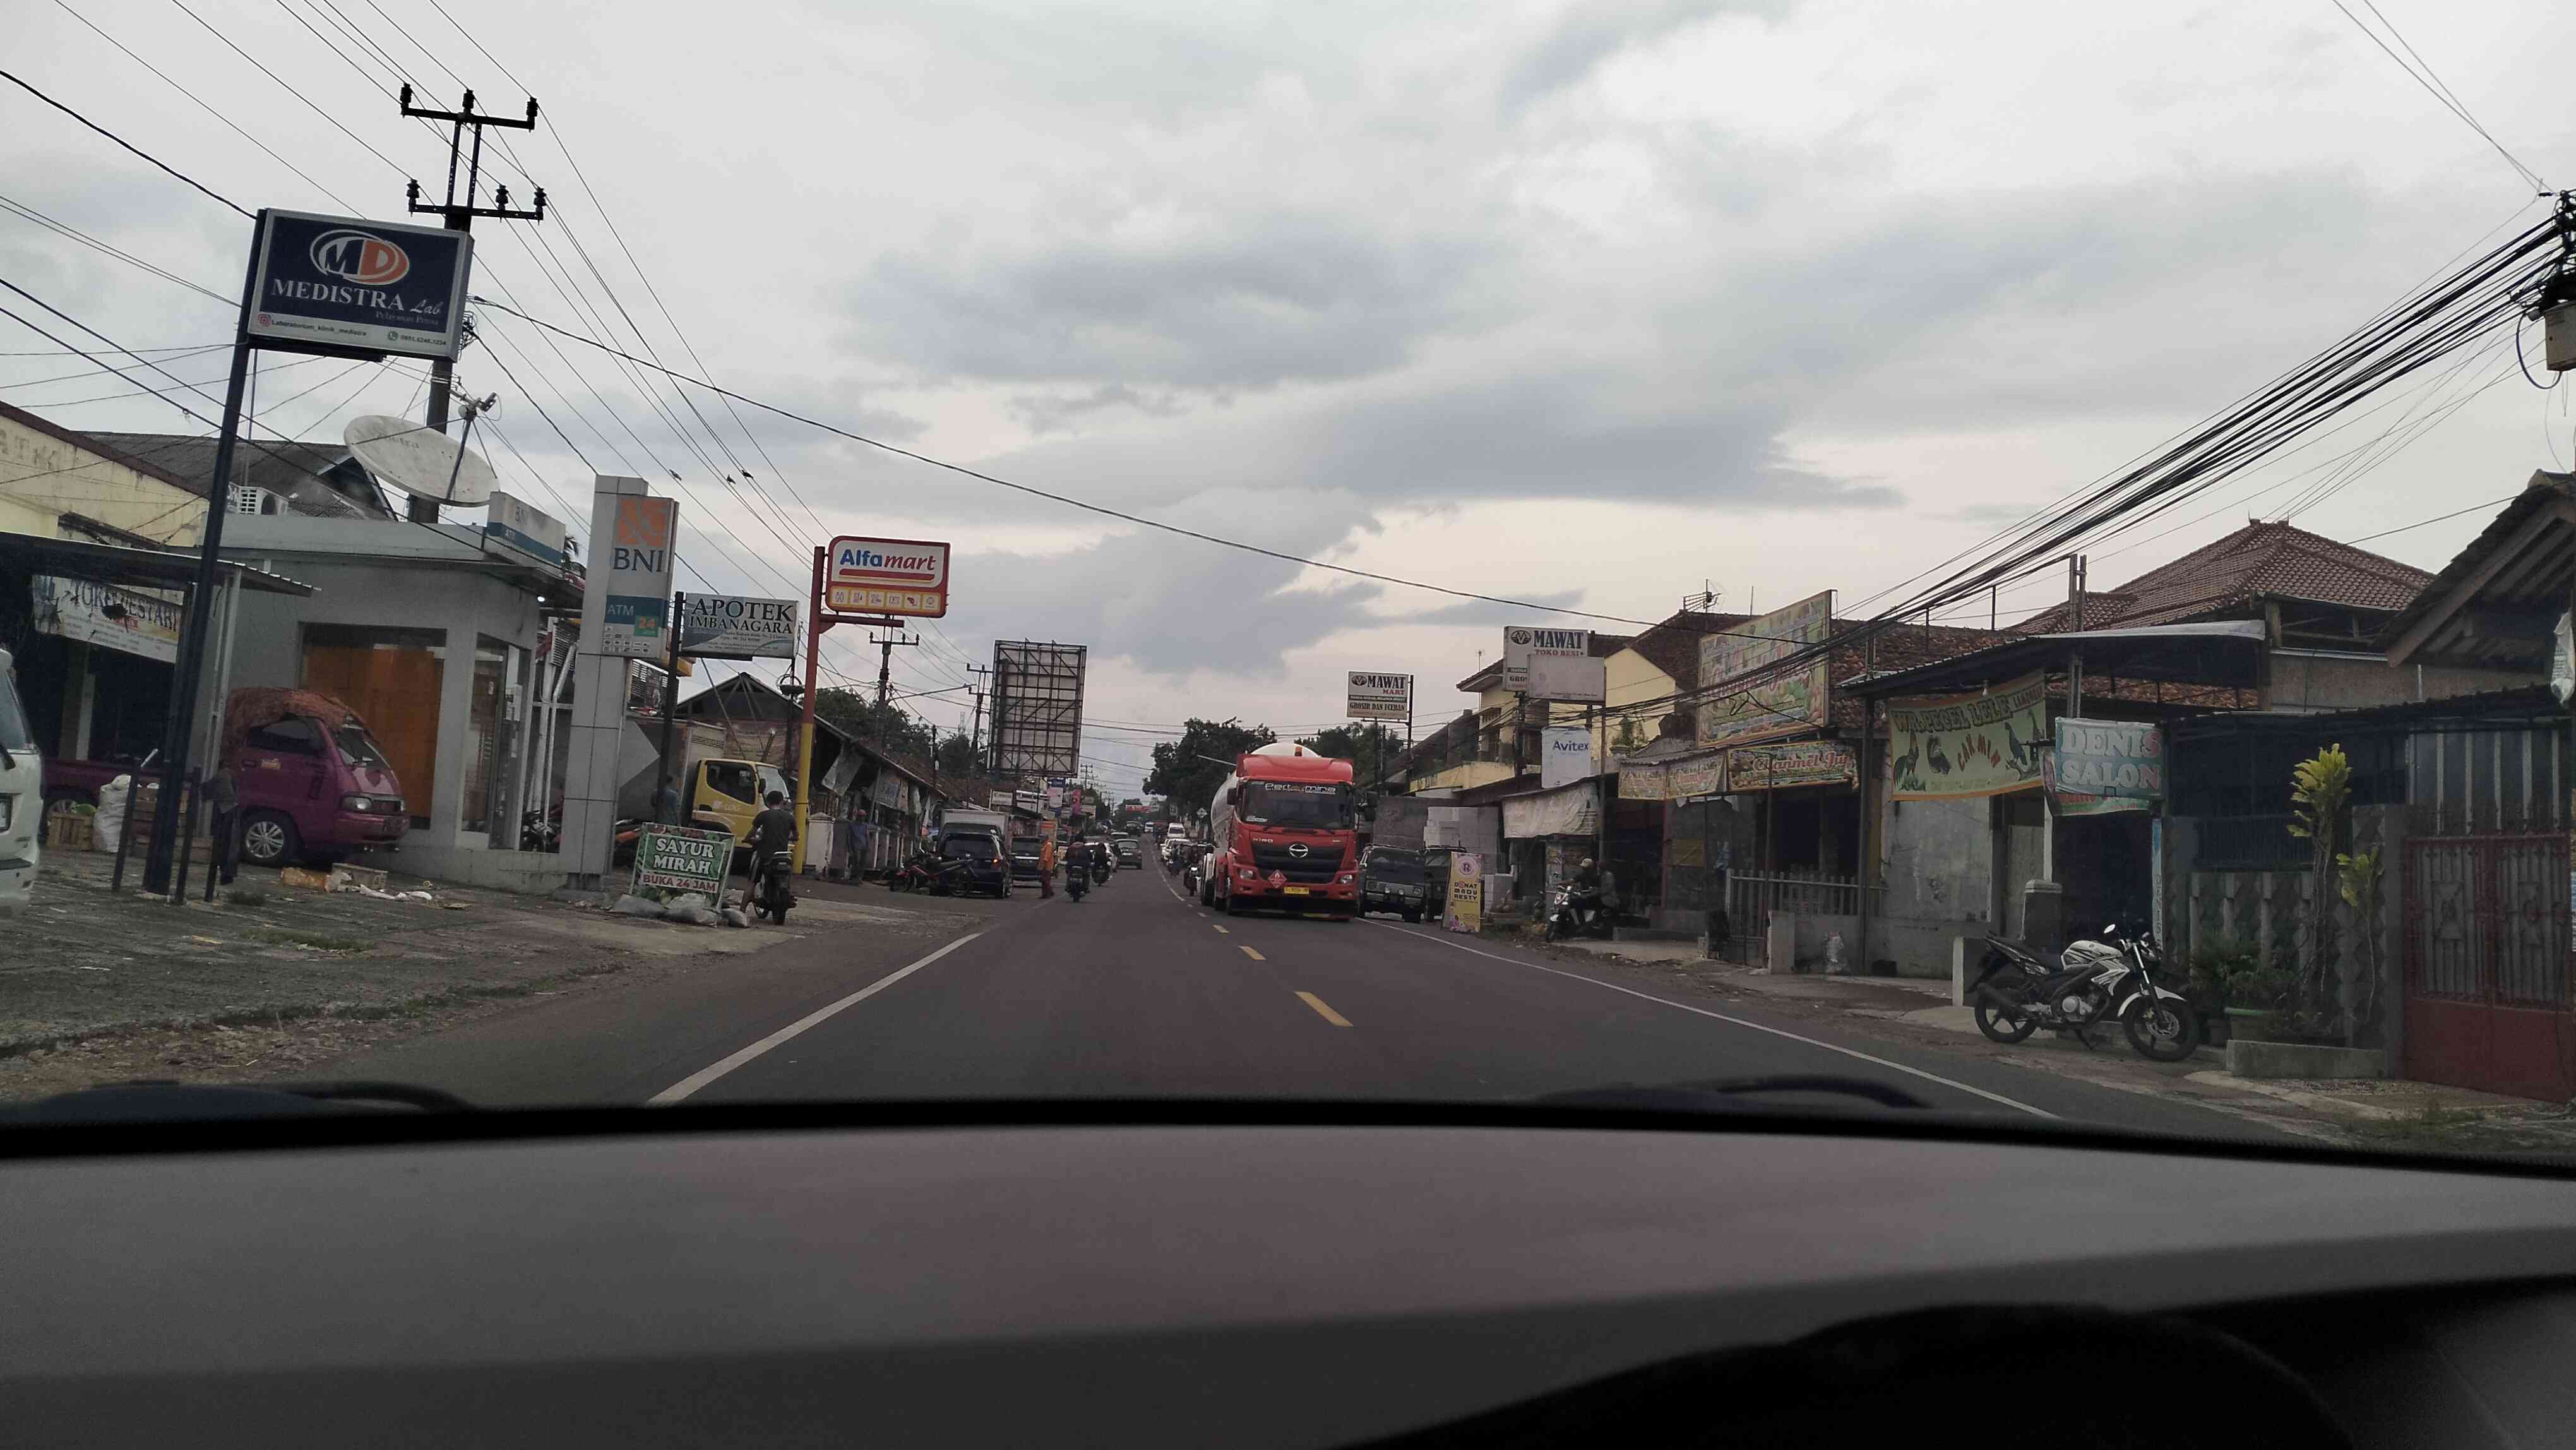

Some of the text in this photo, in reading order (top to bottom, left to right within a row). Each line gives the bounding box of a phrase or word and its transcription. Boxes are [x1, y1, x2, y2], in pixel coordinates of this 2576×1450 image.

[271, 278, 443, 315] MEDISTRA Lab
[612, 547, 665, 573] BNI
[839, 549, 936, 571] Alfamart
[606, 604, 635, 616] ATM
[691, 597, 794, 622] APOTEK
[638, 616, 657, 629] 24
[689, 616, 793, 634] IMBANAGARA
[1533, 630, 1584, 649] MAWAT
[1368, 675, 1405, 689] MAWAT
[1372, 702, 1383, 710] DAN
[1967, 697, 2011, 726] LELE
[1552, 740, 1589, 752] Avitex
[2060, 726, 2162, 758] DENIS
[2061, 759, 2161, 789] SALON
[656, 837, 714, 858] SAYUR
[653, 855, 712, 875] MIRAH
[642, 873, 716, 892] BUKA 24 JAM
